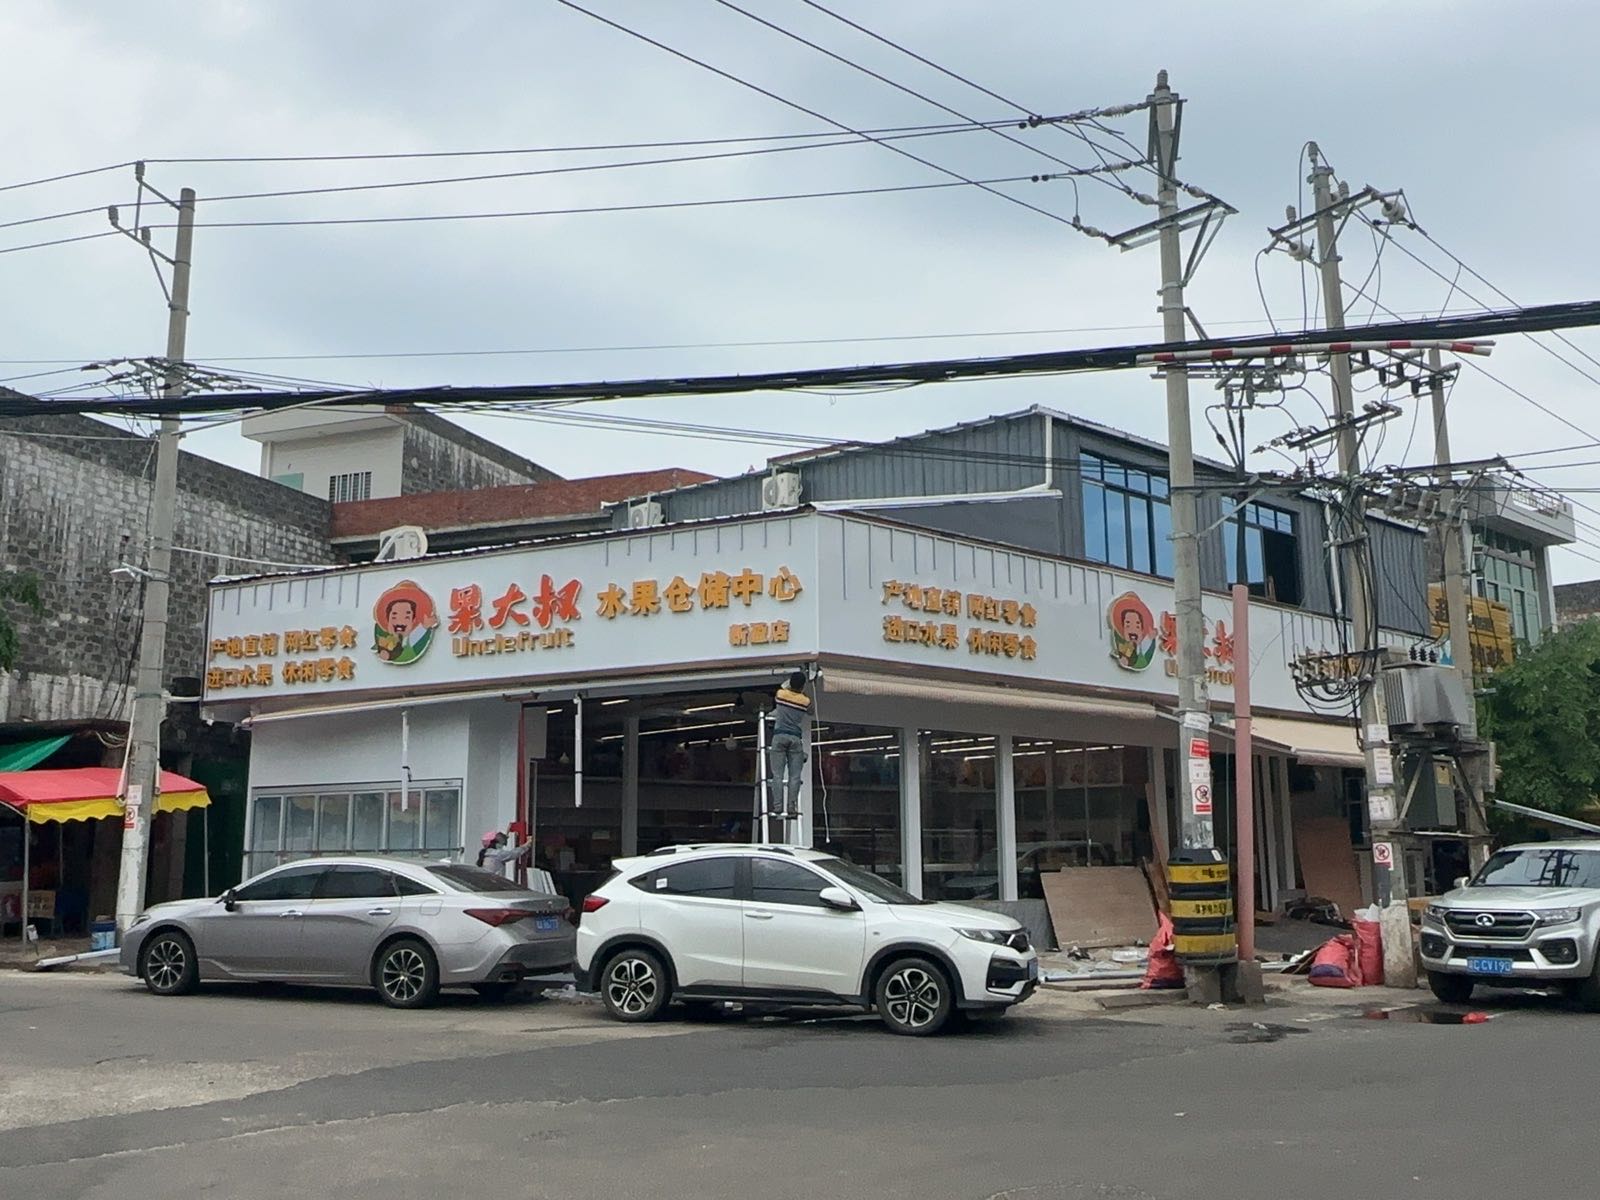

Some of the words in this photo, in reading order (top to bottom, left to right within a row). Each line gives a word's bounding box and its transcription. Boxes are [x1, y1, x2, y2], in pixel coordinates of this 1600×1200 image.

[448, 574, 582, 636] 果大叔
[596, 566, 803, 619] 水果仓储中心
[882, 580, 961, 617] 产地直销
[967, 594, 1037, 628] 网红零食
[209, 633, 280, 661] 产地直销
[285, 625, 358, 653] 网红零食
[883, 615, 959, 650] 进口水果
[966, 627, 1037, 660] 休闲零食
[207, 663, 273, 691] 进口水果
[283, 656, 355, 684] 休闲零食
